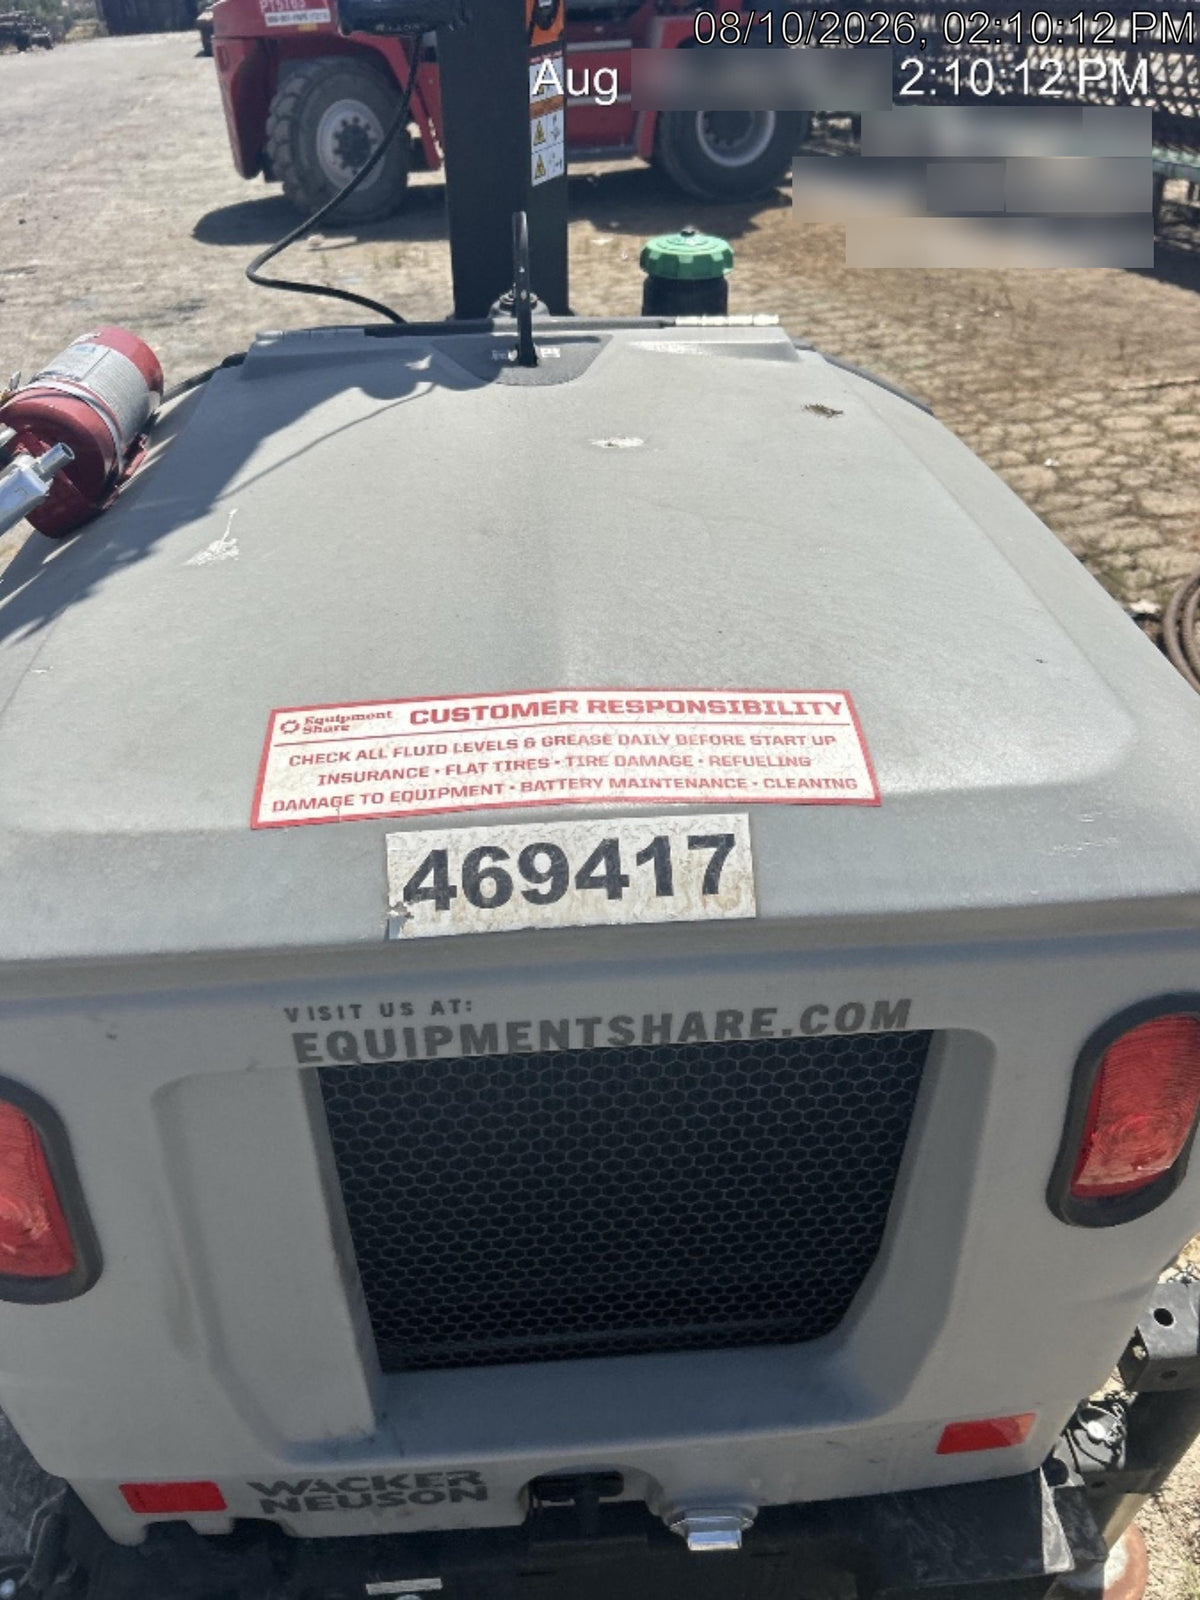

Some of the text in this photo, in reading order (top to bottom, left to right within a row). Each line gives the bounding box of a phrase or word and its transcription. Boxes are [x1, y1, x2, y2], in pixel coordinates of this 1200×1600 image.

[304, 710, 393, 726] Equipment
[409, 699, 842, 726] CUSTOMER RESPONSIBILITY
[302, 723, 350, 735] Share
[289, 750, 351, 767] CHECK
[355, 748, 388, 761] ALL
[393, 743, 448, 758] FLUID
[453, 739, 519, 754] LEVELS
[541, 734, 612, 747] GREASE
[618, 734, 670, 746] DAILY
[676, 735, 745, 746] BEFORE
[750, 735, 805, 746] START
[812, 735, 836, 746] UP
[317, 755, 811, 786] INSURANCE FLAT TIRES TIRE DAMAGE REFUELING
[272, 777, 858, 812] DAMAGE TO EQUIPMENT BATTERY MAINTENANCE CLEANING
[403, 833, 736, 911] 469417
[284, 999, 472, 1023] VISIT US AT:
[291, 998, 913, 1065] EQUIPMENTSHARE.COM
[246, 1470, 486, 1496] WACKER
[259, 1486, 488, 1514] NEUSON
